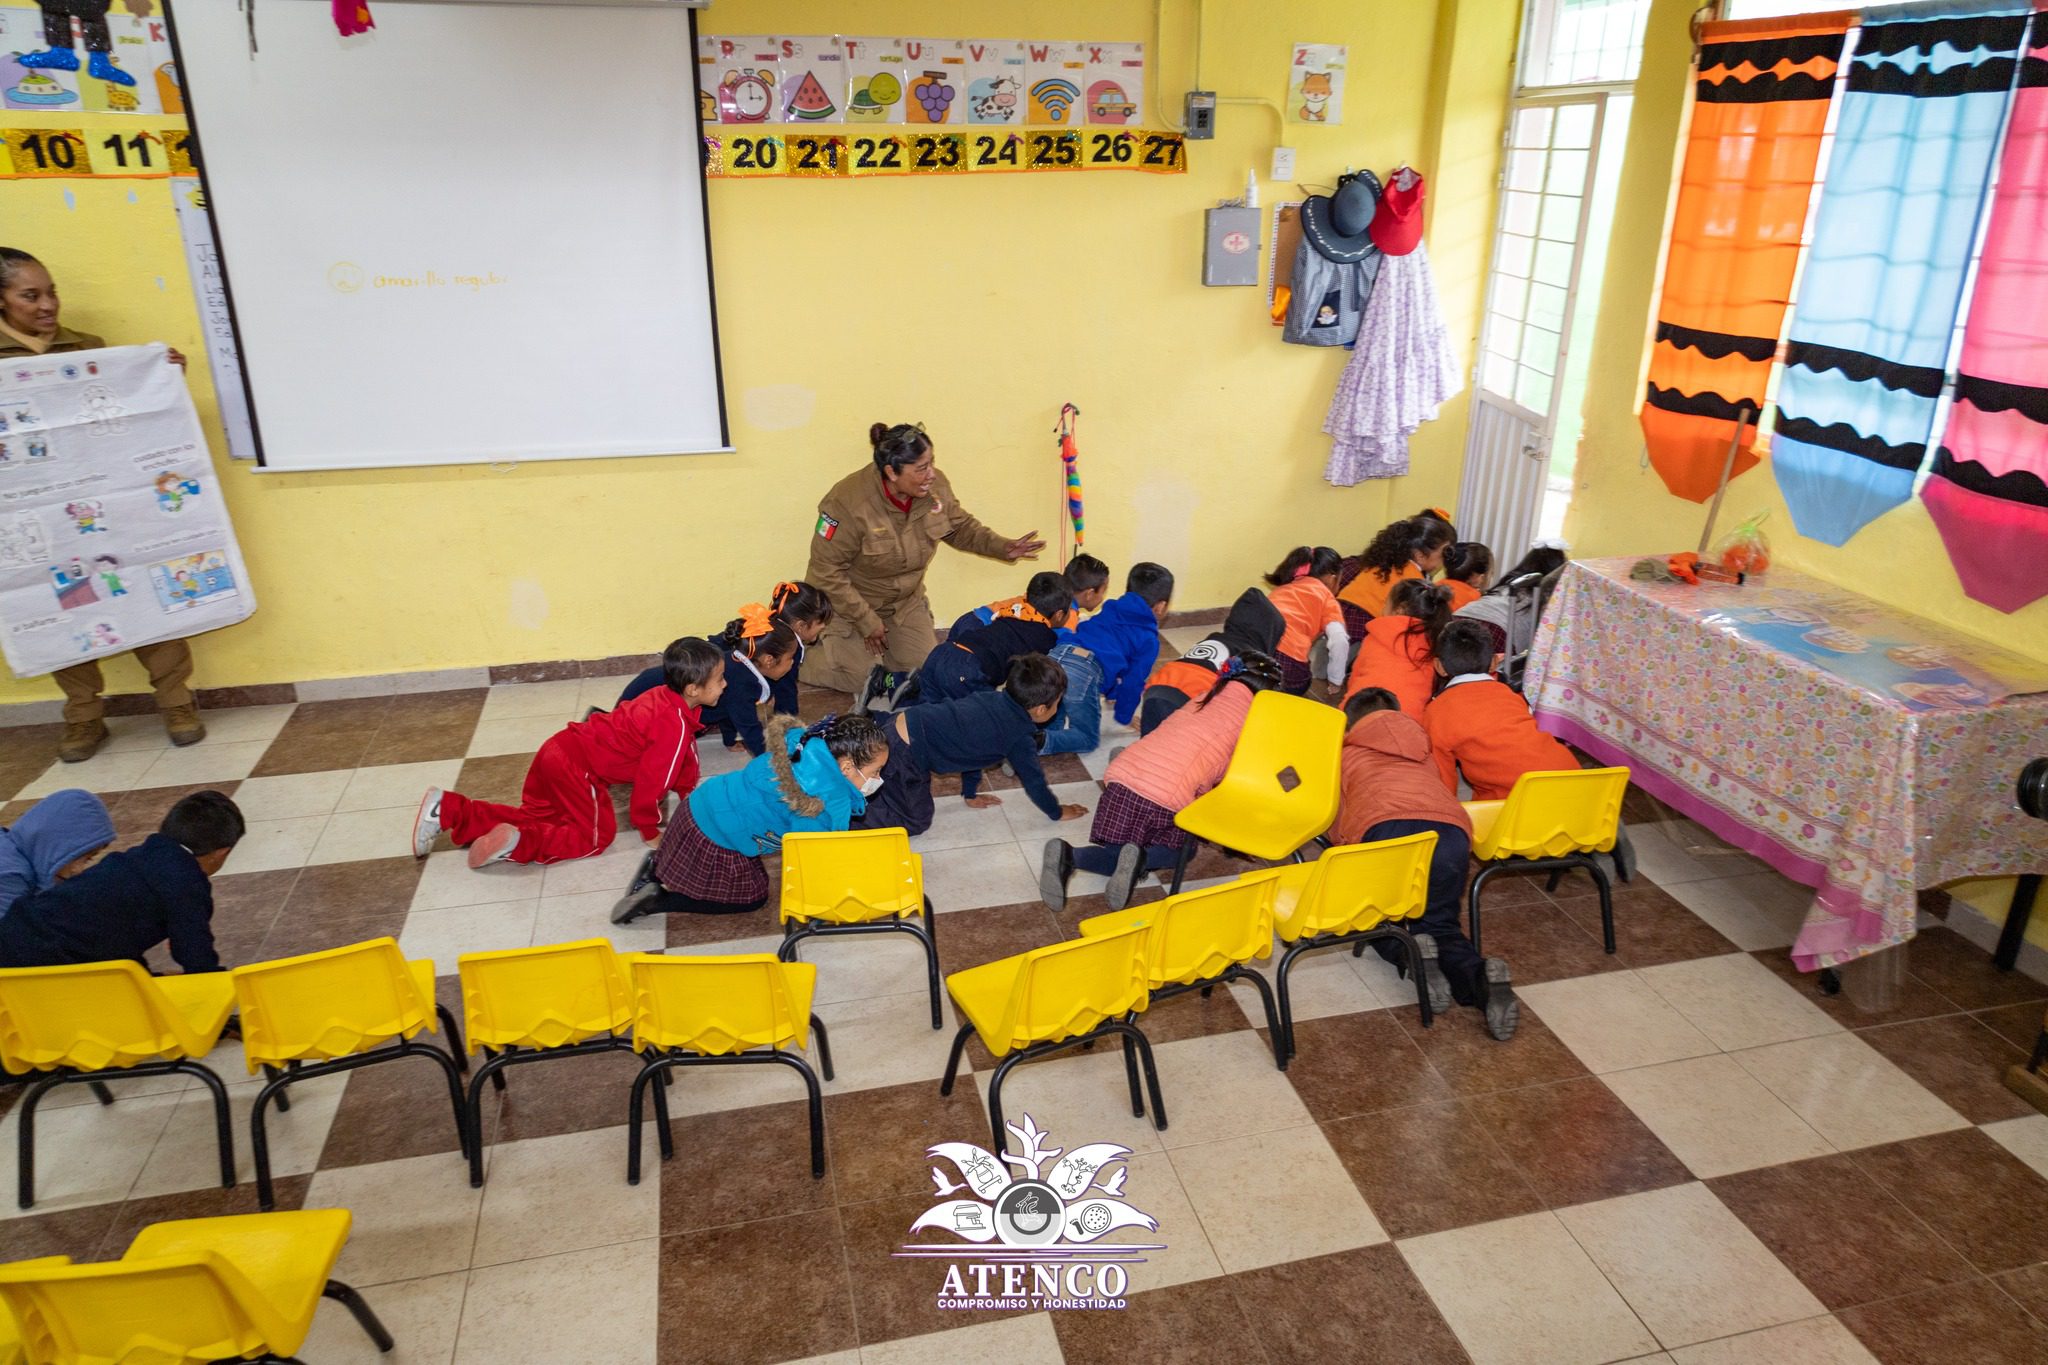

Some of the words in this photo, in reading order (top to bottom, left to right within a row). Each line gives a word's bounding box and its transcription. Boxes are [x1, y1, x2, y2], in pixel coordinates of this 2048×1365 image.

[20, 134, 76, 168] 10
[104, 134, 152, 167] 11
[732, 137, 777, 168] 20
[797, 138, 838, 169] 21
[854, 138, 902, 168] 22
[915, 136, 960, 167] 23
[976, 136, 1017, 165] 24
[1033, 135, 1076, 165] 25
[1092, 134, 1132, 163] 26
[1143, 135, 1183, 166] 27
